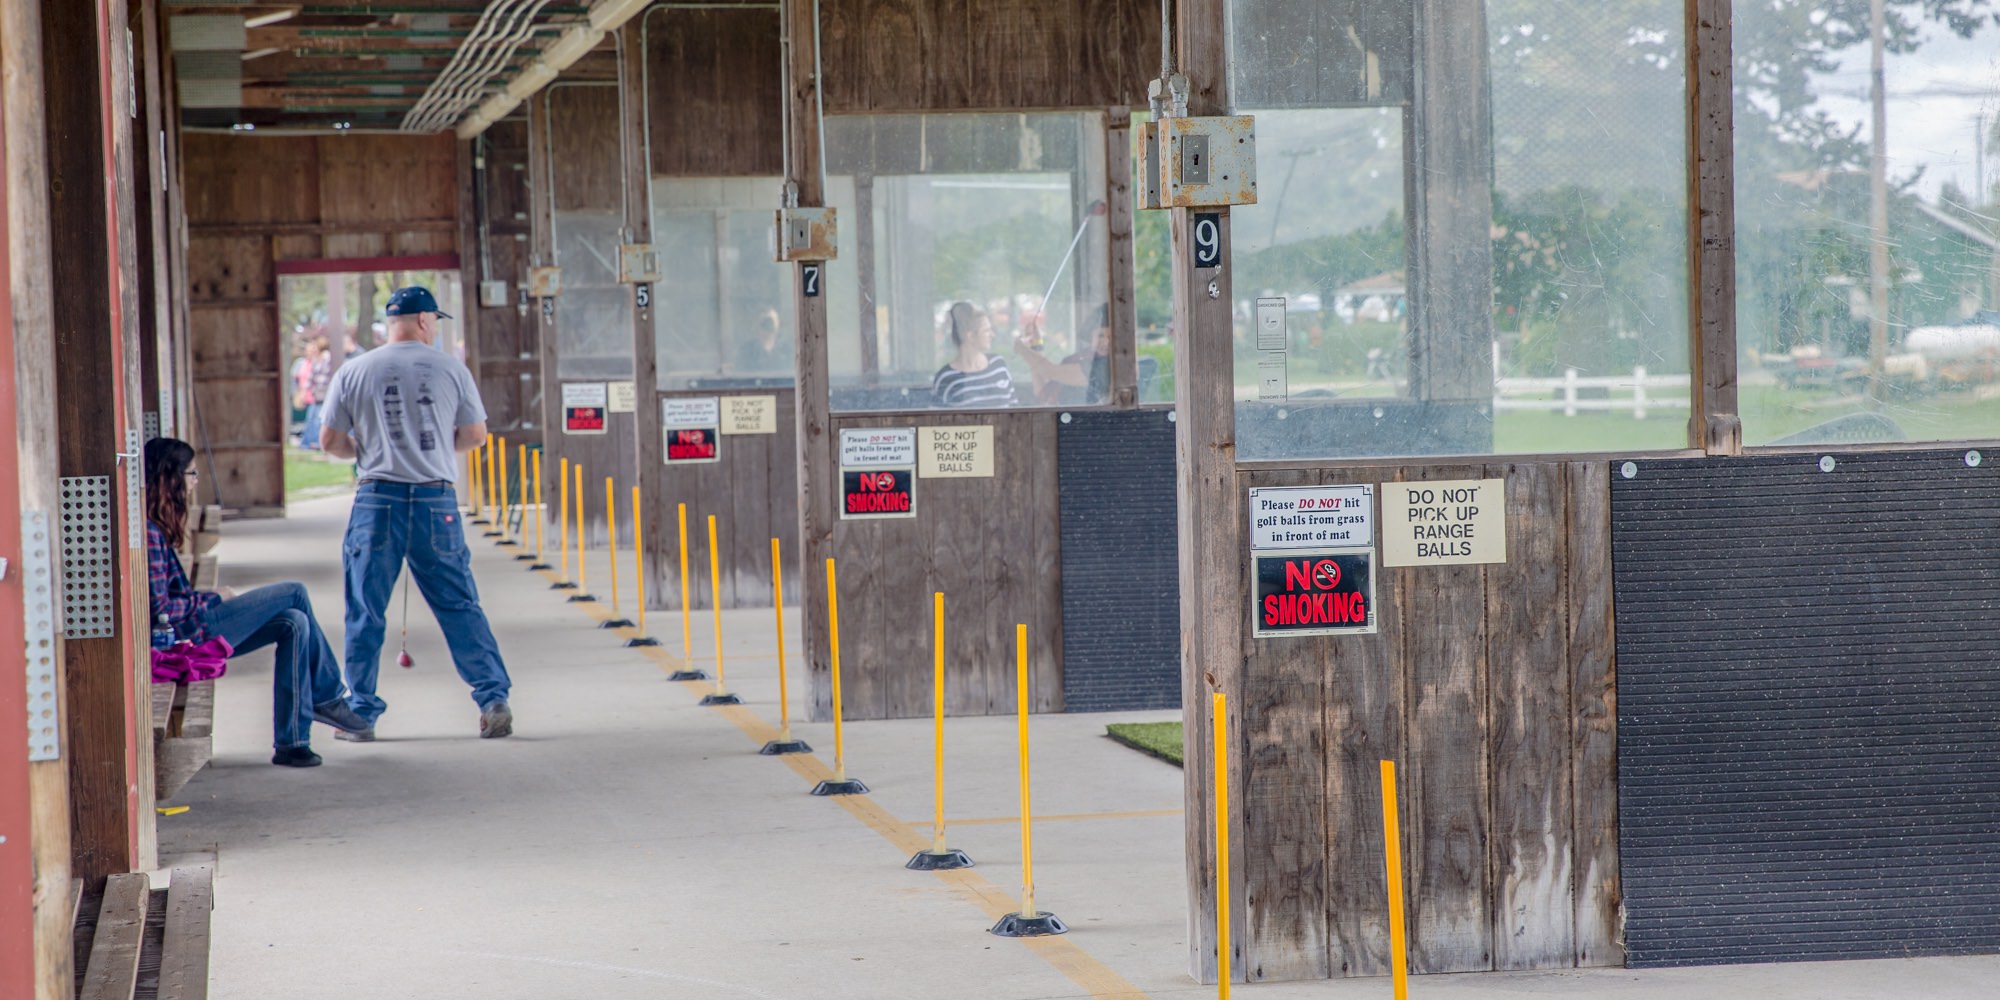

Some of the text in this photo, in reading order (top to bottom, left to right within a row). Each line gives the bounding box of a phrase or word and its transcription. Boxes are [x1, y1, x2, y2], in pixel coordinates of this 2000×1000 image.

[1196, 219, 1219, 262] 9
[804, 266, 819, 293] 7
[637, 286, 648, 306] 5
[543, 299, 553, 314] 3
[677, 430, 705, 444] NO
[934, 431, 976, 441] DO NOT
[934, 442, 977, 451] PICK UP
[937, 452, 974, 461] RANGE
[939, 463, 972, 472] BALLS
[859, 472, 895, 492] NO
[847, 491, 910, 512] SMOKING
[1261, 497, 1360, 511] Please DO NOT hit
[1408, 488, 1478, 505] DO NOT
[1257, 513, 1365, 528] golf balls from grass
[1408, 506, 1480, 522] PICK UP
[1271, 529, 1351, 542] in front of mat
[1413, 524, 1475, 540] RANGE
[1417, 542, 1472, 558] BALLS
[1285, 559, 1342, 591] NO
[1264, 591, 1365, 626] SMOKING
